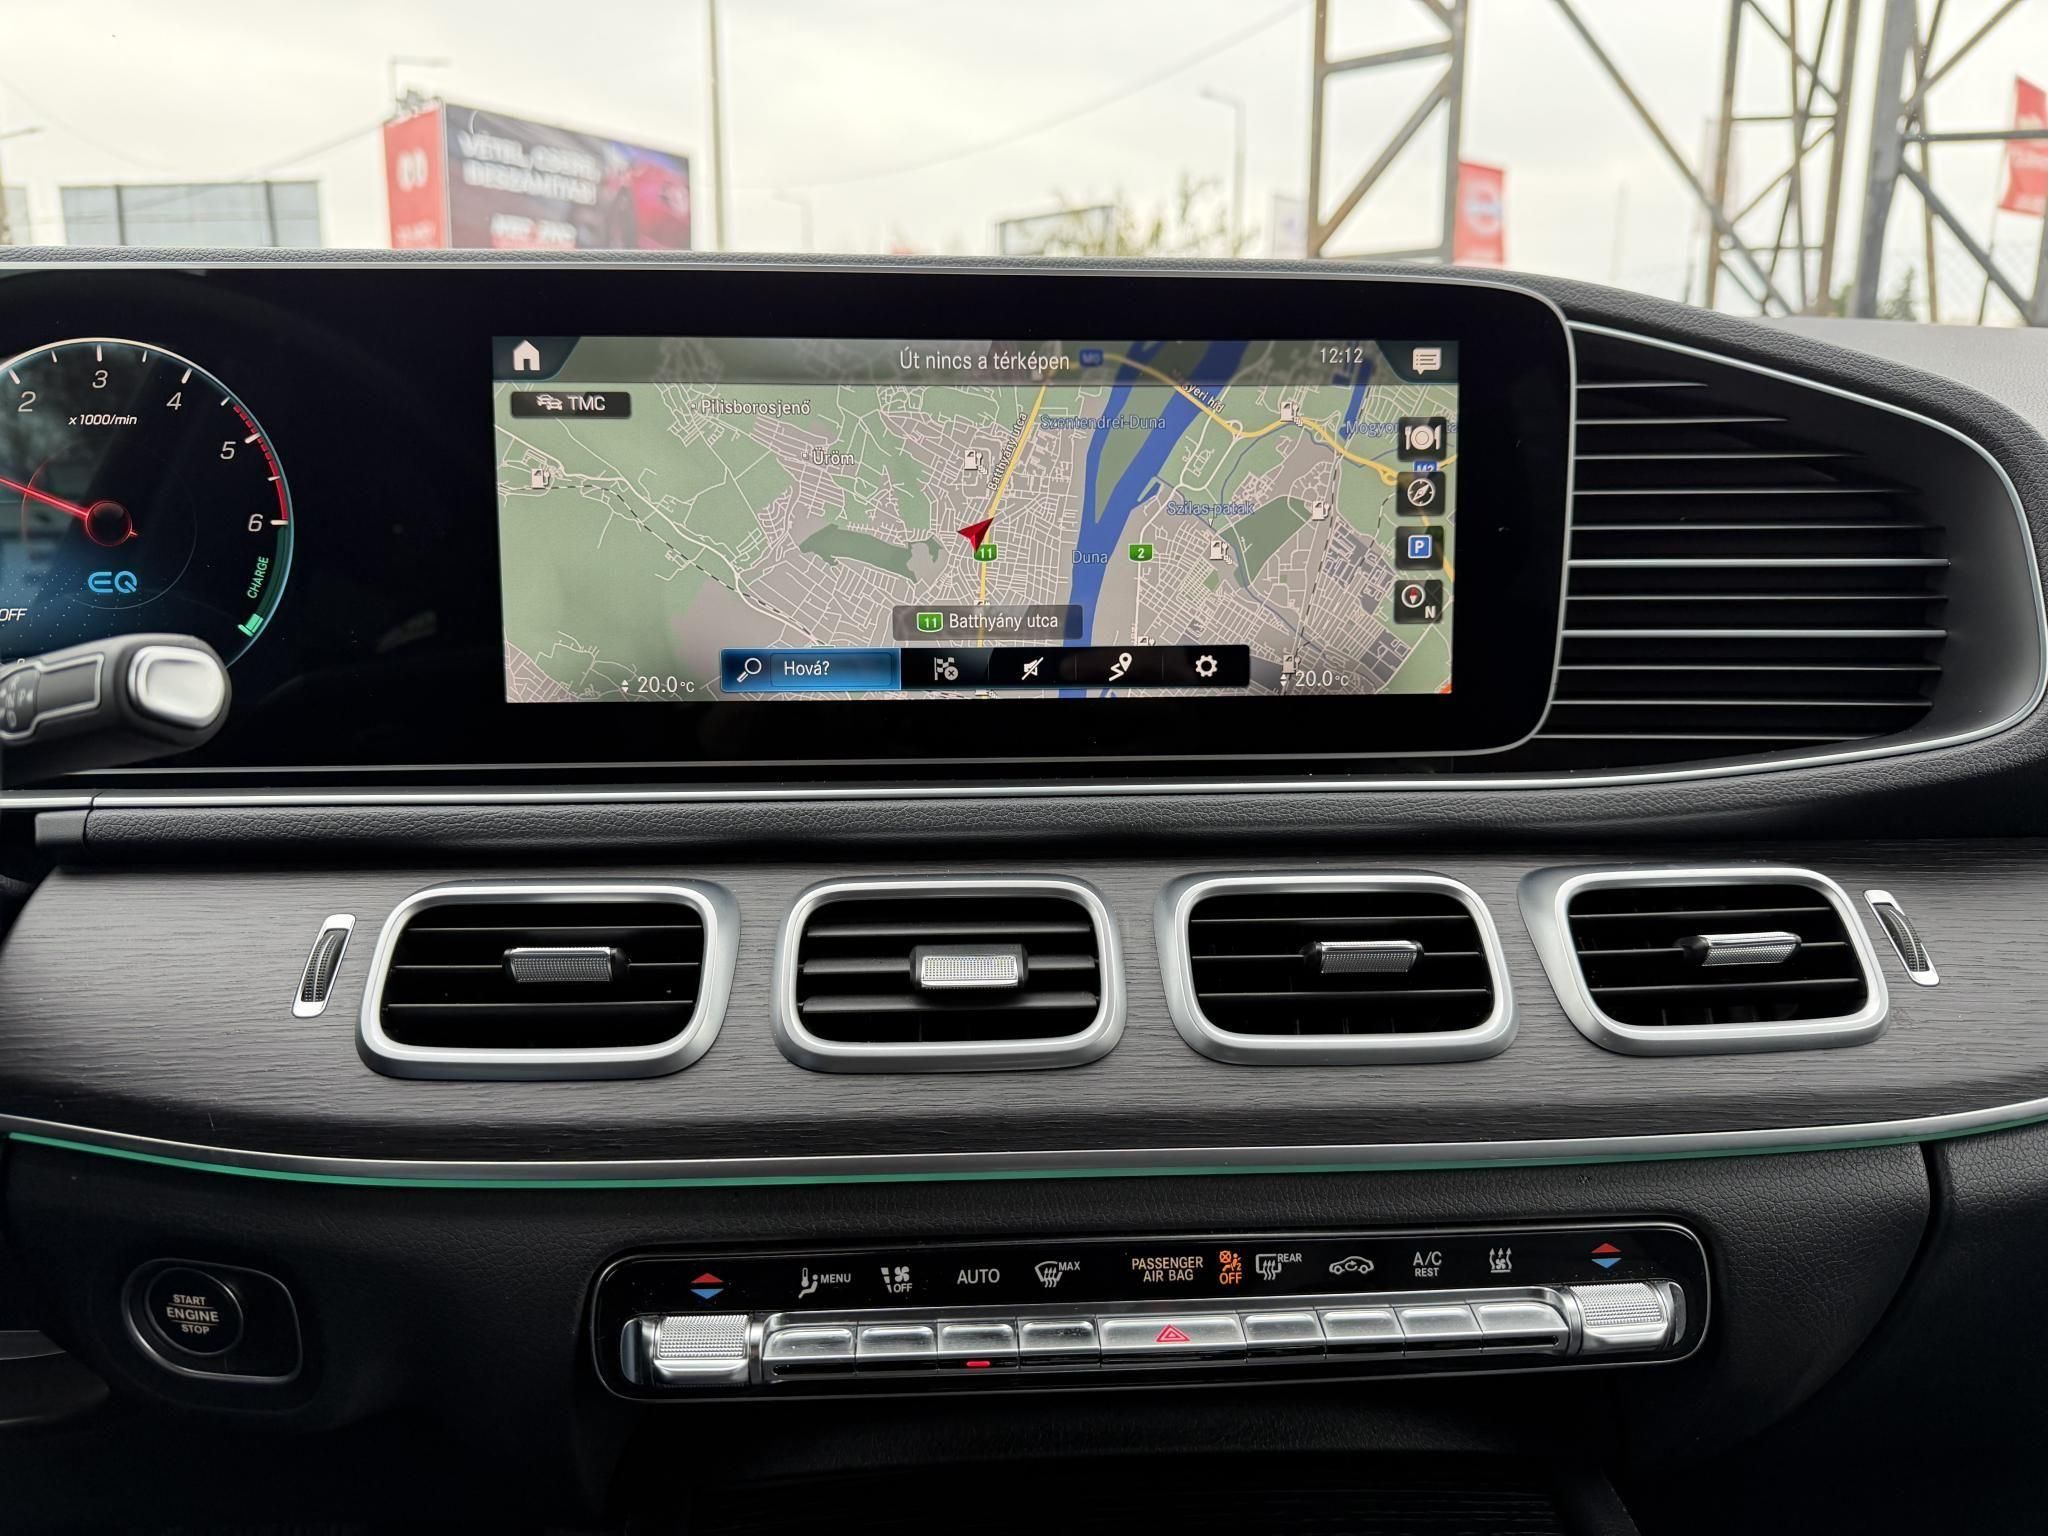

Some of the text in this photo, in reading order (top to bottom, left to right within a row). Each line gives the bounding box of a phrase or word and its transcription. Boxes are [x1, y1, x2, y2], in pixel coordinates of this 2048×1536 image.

[900, 346, 1070, 371] Út nincs a térképen
[1320, 348, 1363, 364] 12:12
[92, 370, 108, 388] 3
[18, 391, 36, 412] 2
[166, 392, 182, 410] 4
[567, 396, 606, 412] TMC
[701, 399, 811, 418] Pilisborosjenő
[1040, 413, 1166, 430] Szentendrei-Duna
[220, 441, 236, 460] 5
[812, 446, 855, 466] Üröm
[987, 412, 1028, 491] Batthyány utca
[248, 514, 263, 532] 6
[981, 548, 992, 559] 11
[1137, 547, 1145, 559] 2
[1414, 540, 1424, 554] P
[1072, 550, 1108, 564] Duna
[87, 570, 137, 594] EQ
[246, 556, 269, 599] CHARGE
[1425, 606, 1436, 618] N
[924, 613, 1058, 632] 11 Batthyány utca
[784, 660, 830, 676] Hová?
[1131, 1256, 1203, 1270] PASSENGER
[1276, 1252, 1302, 1264] REAR
[1413, 1251, 1442, 1267] A/C
[1058, 1261, 1081, 1272] MAX
[1414, 1267, 1439, 1277] REST
[820, 1273, 851, 1285] MENU
[956, 1268, 1001, 1285] AUTO
[1143, 1269, 1194, 1282] AIR BAG
[1219, 1271, 1243, 1284] OFF
[893, 1282, 913, 1294] OFF
[172, 1294, 206, 1306] START
[166, 1307, 219, 1322] ENGINE
[181, 1323, 210, 1334] STOP
